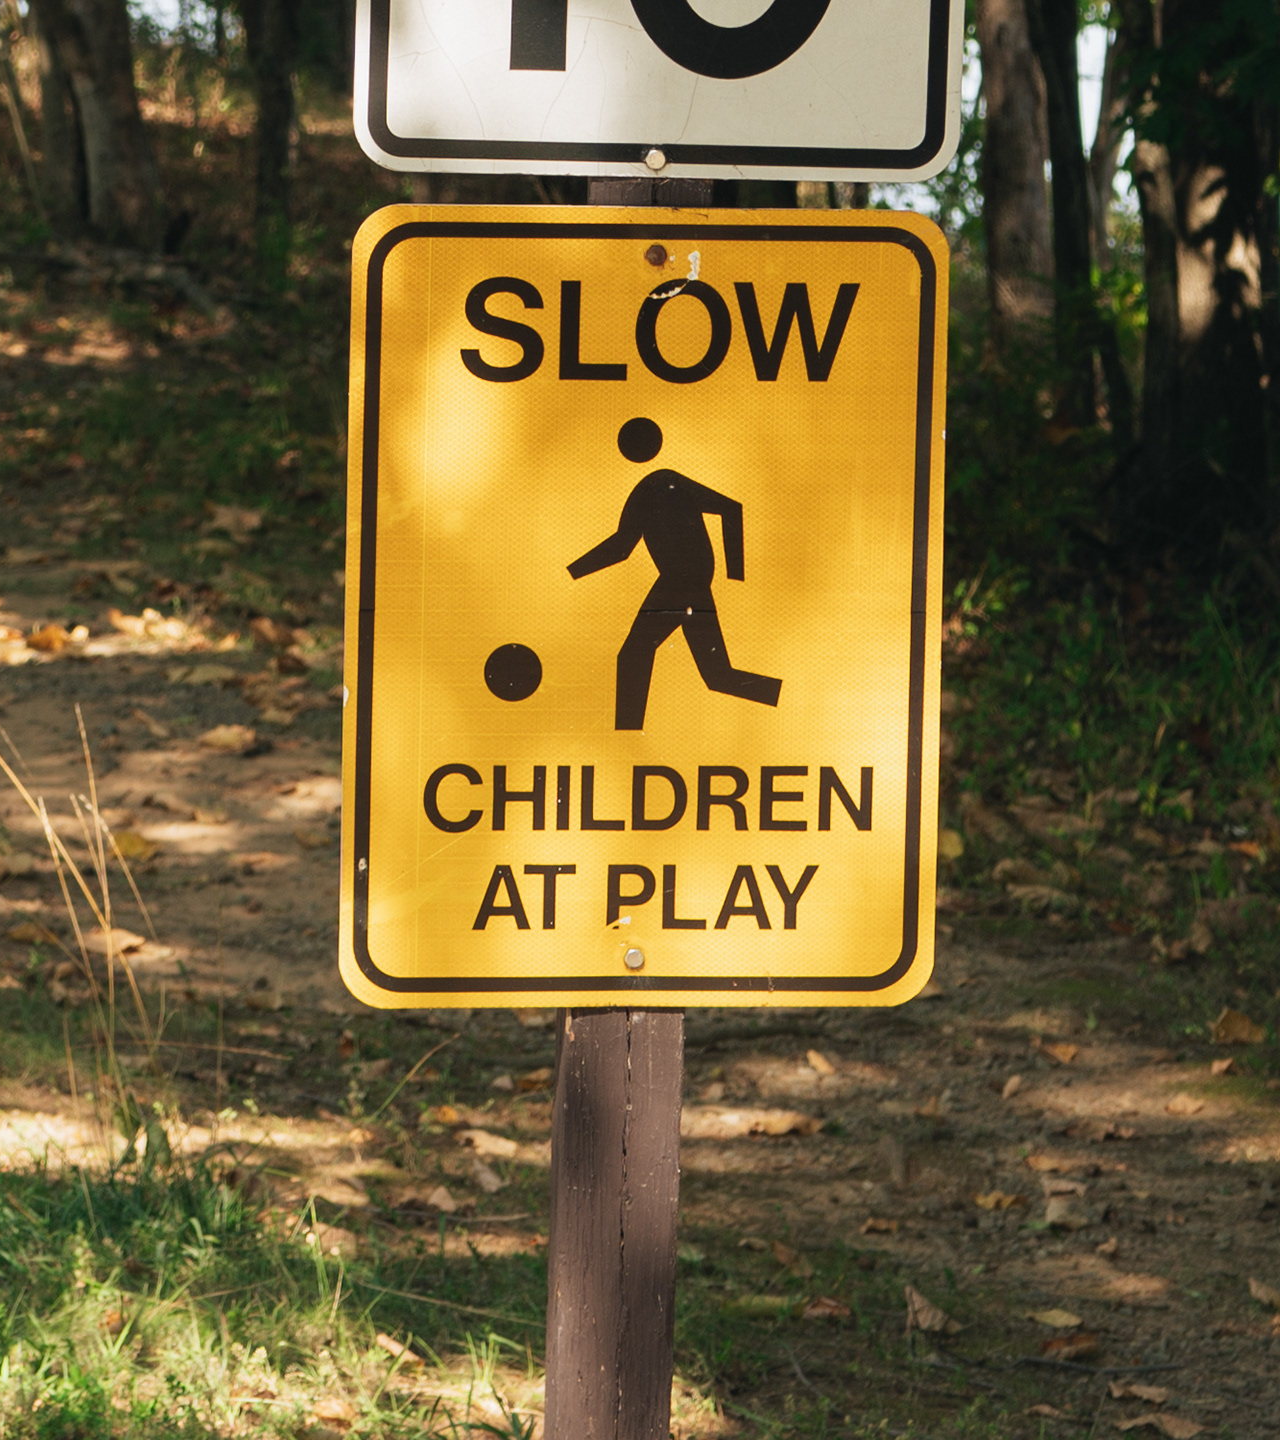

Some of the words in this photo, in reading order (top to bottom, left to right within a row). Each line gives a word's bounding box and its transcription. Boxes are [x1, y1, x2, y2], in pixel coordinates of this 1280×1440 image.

[460, 277, 860, 384] SLOW
[423, 763, 873, 833] CHILDREN
[472, 865, 576, 930] AT
[606, 864, 819, 930] PLAY
